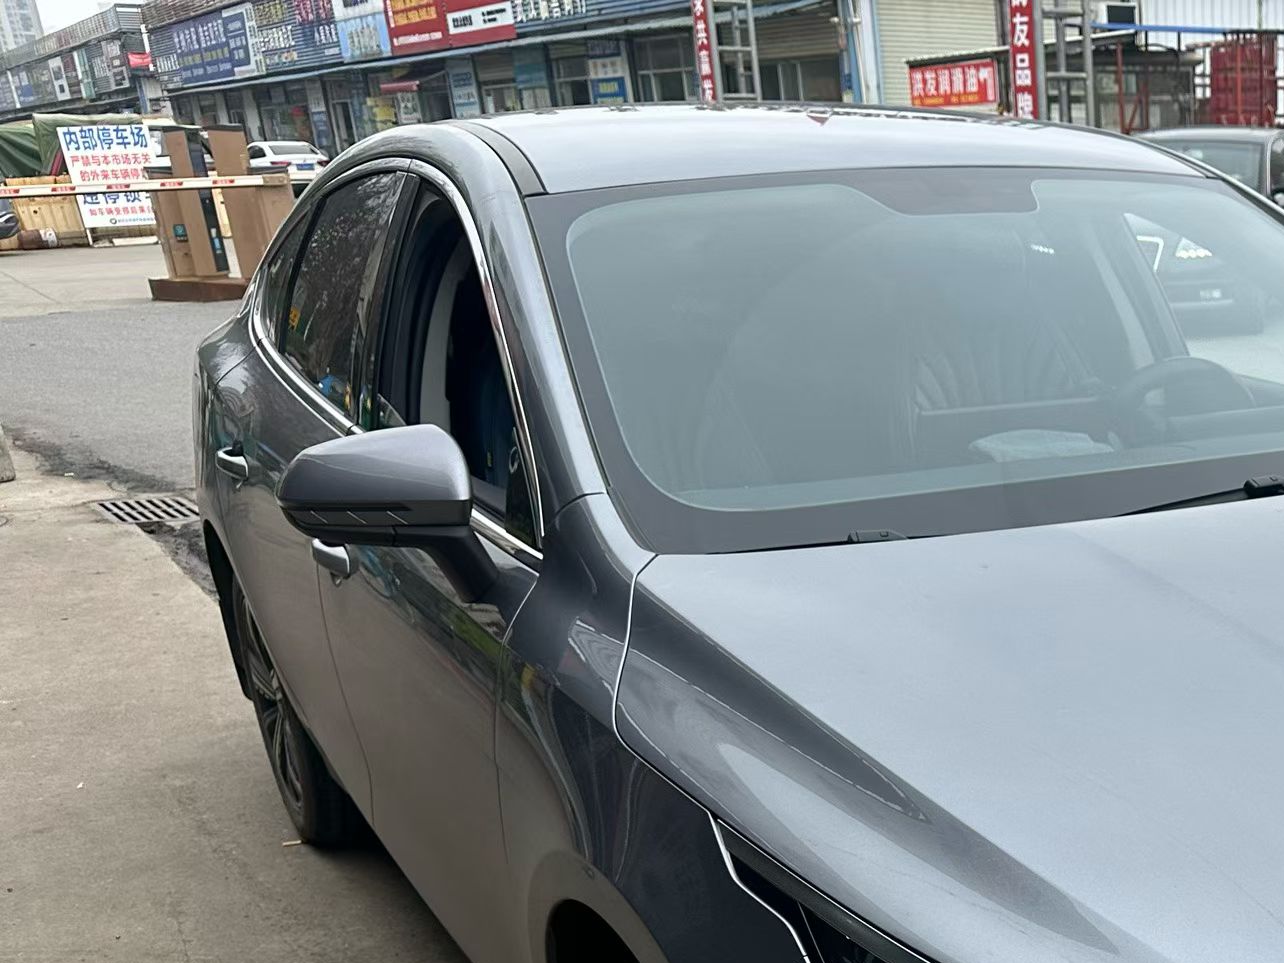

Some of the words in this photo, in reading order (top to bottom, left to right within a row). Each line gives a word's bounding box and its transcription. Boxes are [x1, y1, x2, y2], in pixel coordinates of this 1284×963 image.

[63, 126, 148, 151] 内部停车场
[70, 154, 151, 168] 严禁与本市场无关
[80, 168, 147, 182] 的外来车辆停
[83, 191, 151, 205] 违停锁
